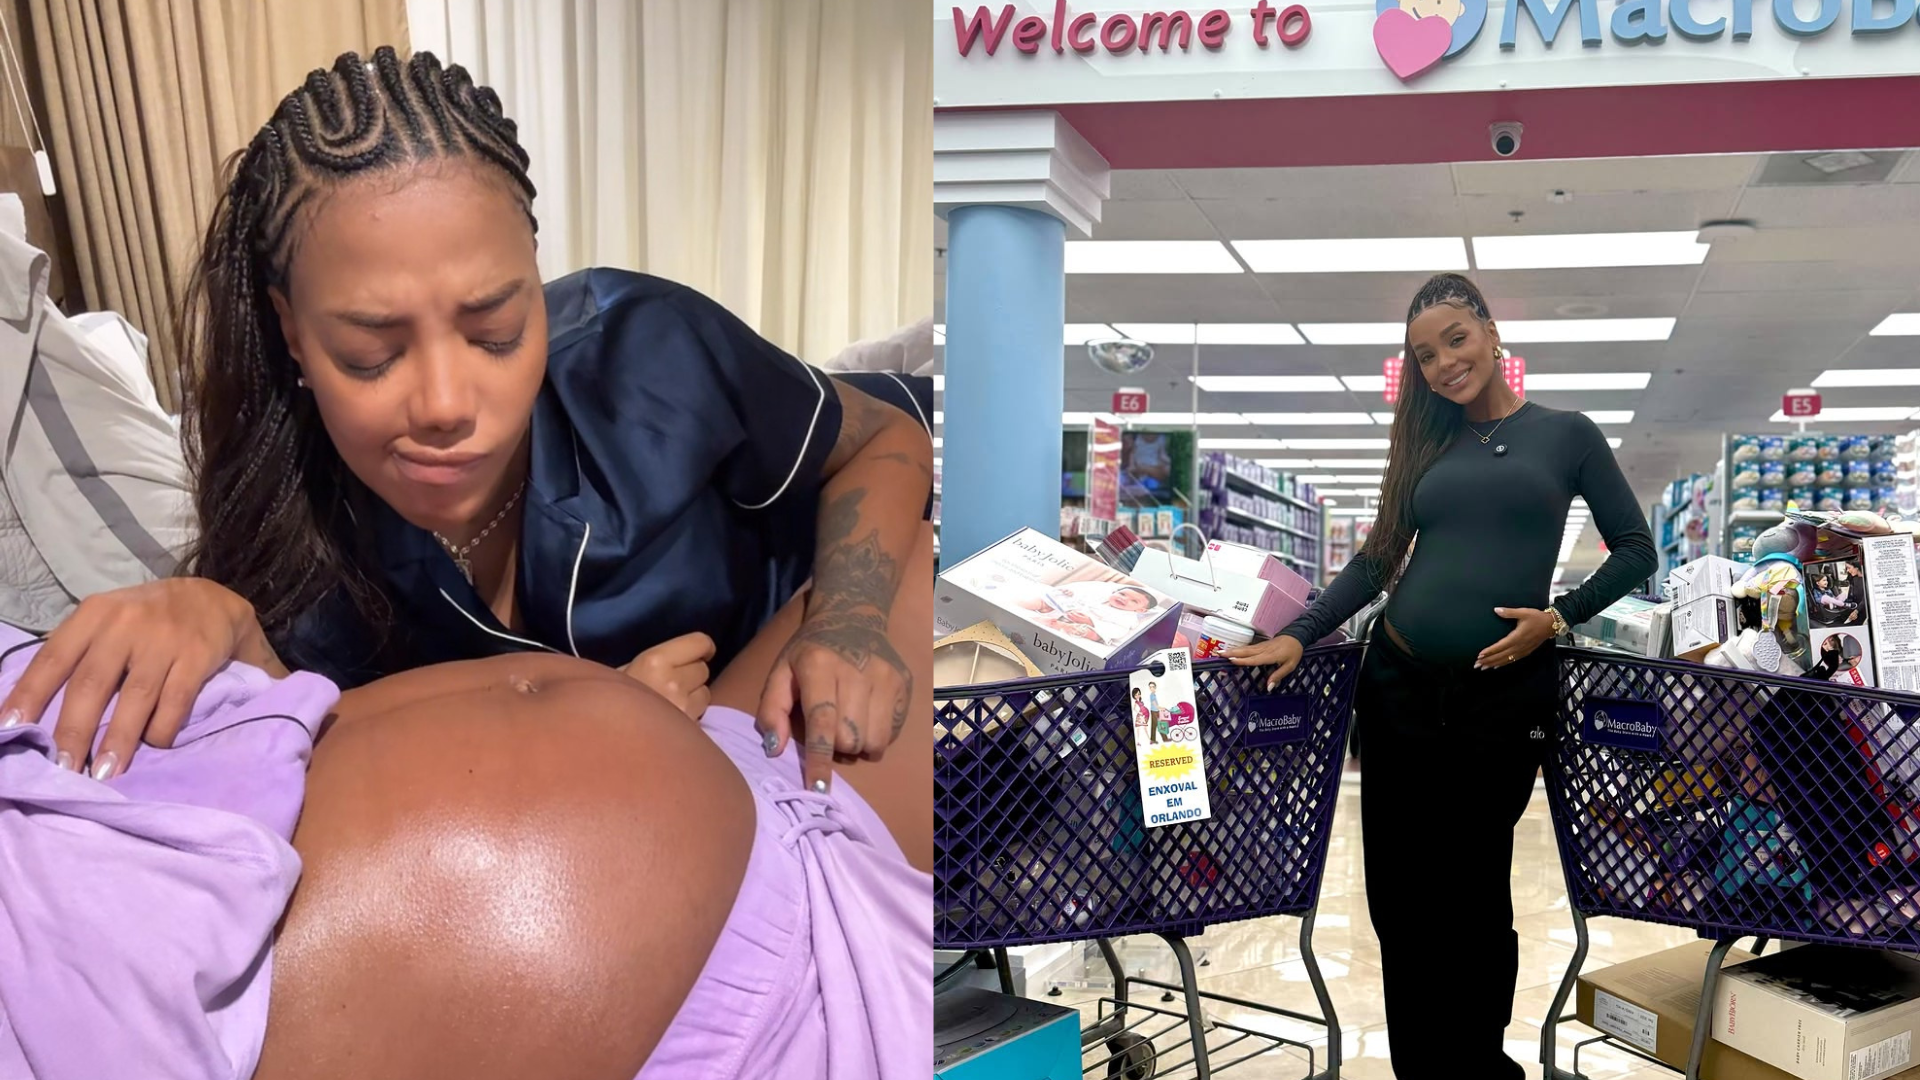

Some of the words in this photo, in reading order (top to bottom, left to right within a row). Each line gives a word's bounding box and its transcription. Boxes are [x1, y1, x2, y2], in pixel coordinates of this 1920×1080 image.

[952, 0, 1230, 58] Welcome
[1251, 0, 1311, 47] to
[1500, 0, 1920, 50] MacroB
[1120, 394, 1139, 411] E6
[1792, 398, 1812, 414] E5
[1259, 714, 1302, 728] MacroBaby
[1607, 718, 1657, 738] MacroBaby
[1530, 725, 1545, 740] alo
[1149, 755, 1193, 769] RESERVED
[1148, 781, 1198, 796] ENXOVAL
[1166, 797, 1183, 808] EM
[1150, 807, 1202, 824] ORLANDO
